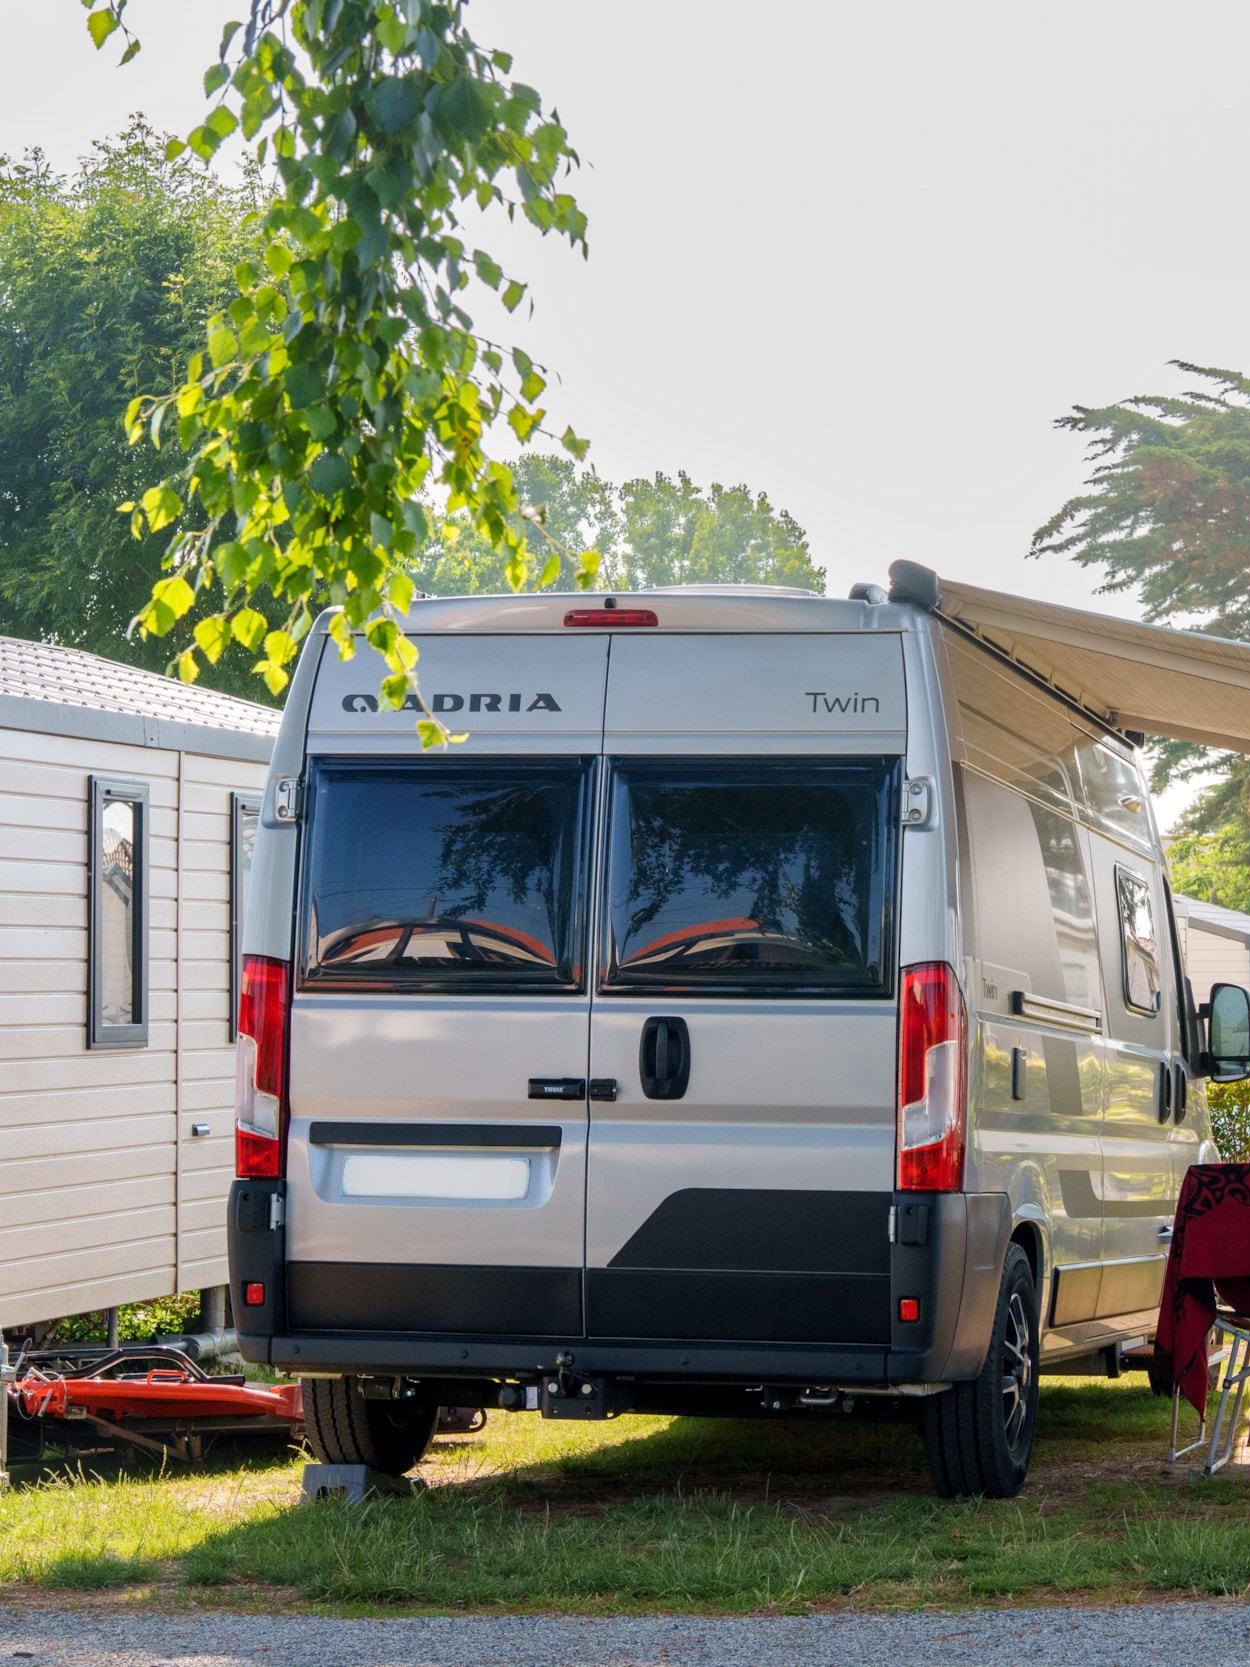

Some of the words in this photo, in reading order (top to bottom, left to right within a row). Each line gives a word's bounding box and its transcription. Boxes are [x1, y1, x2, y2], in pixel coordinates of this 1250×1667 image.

[393, 693, 562, 713] ADRIA
[804, 692, 880, 713] Twin
[982, 976, 998, 1001] Twin
